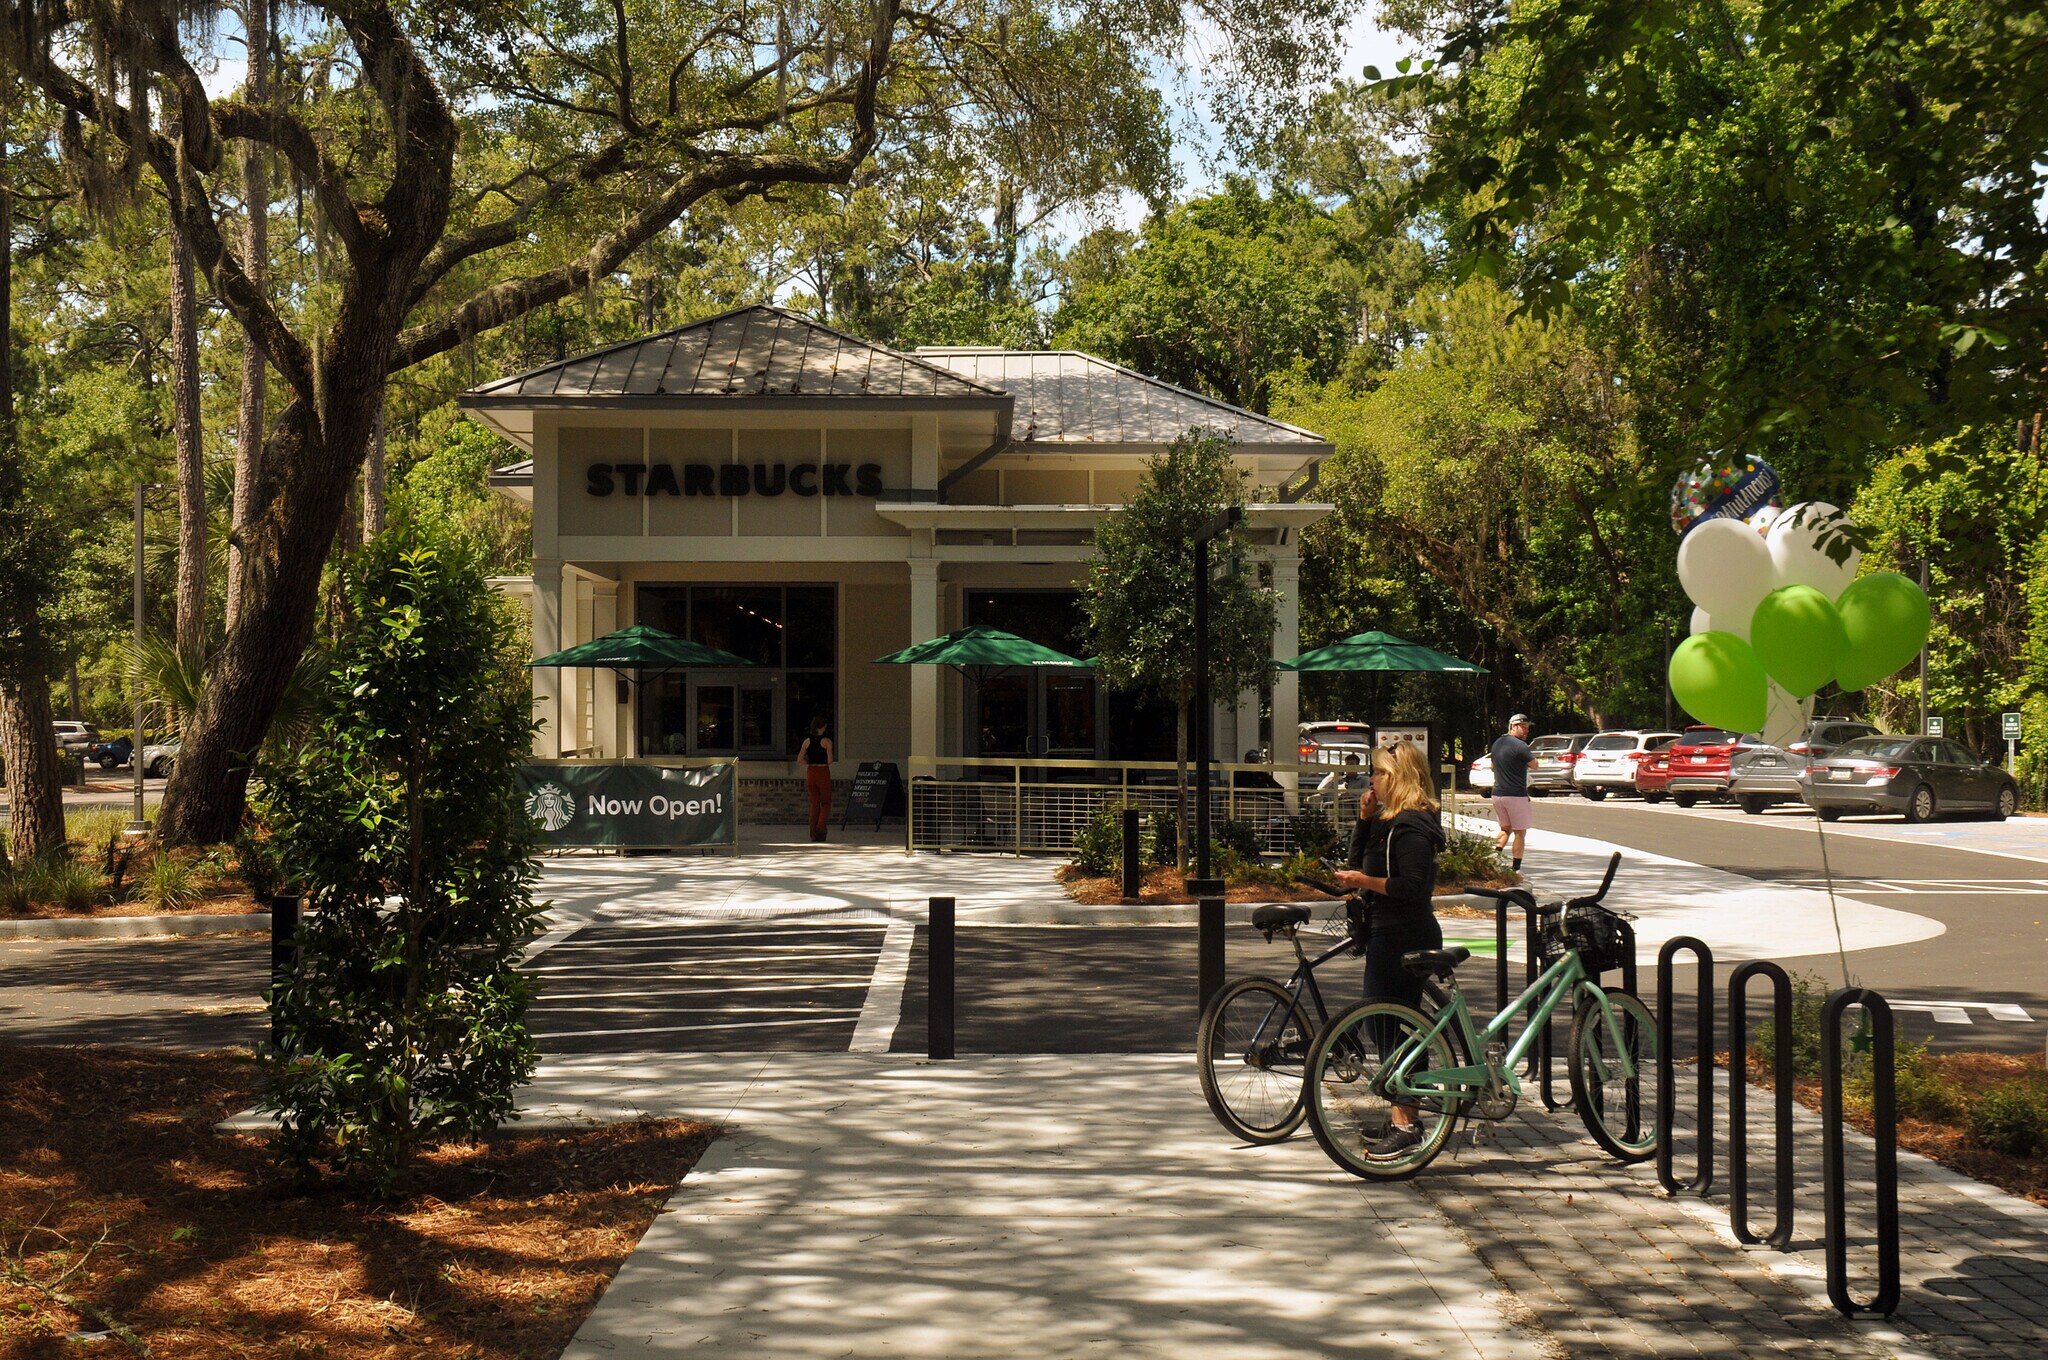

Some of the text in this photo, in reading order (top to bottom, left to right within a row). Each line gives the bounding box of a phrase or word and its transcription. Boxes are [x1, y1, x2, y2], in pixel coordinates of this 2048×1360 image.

[587, 463, 882, 496] STARBUCKS
[589, 793, 722, 819] Now Open!
